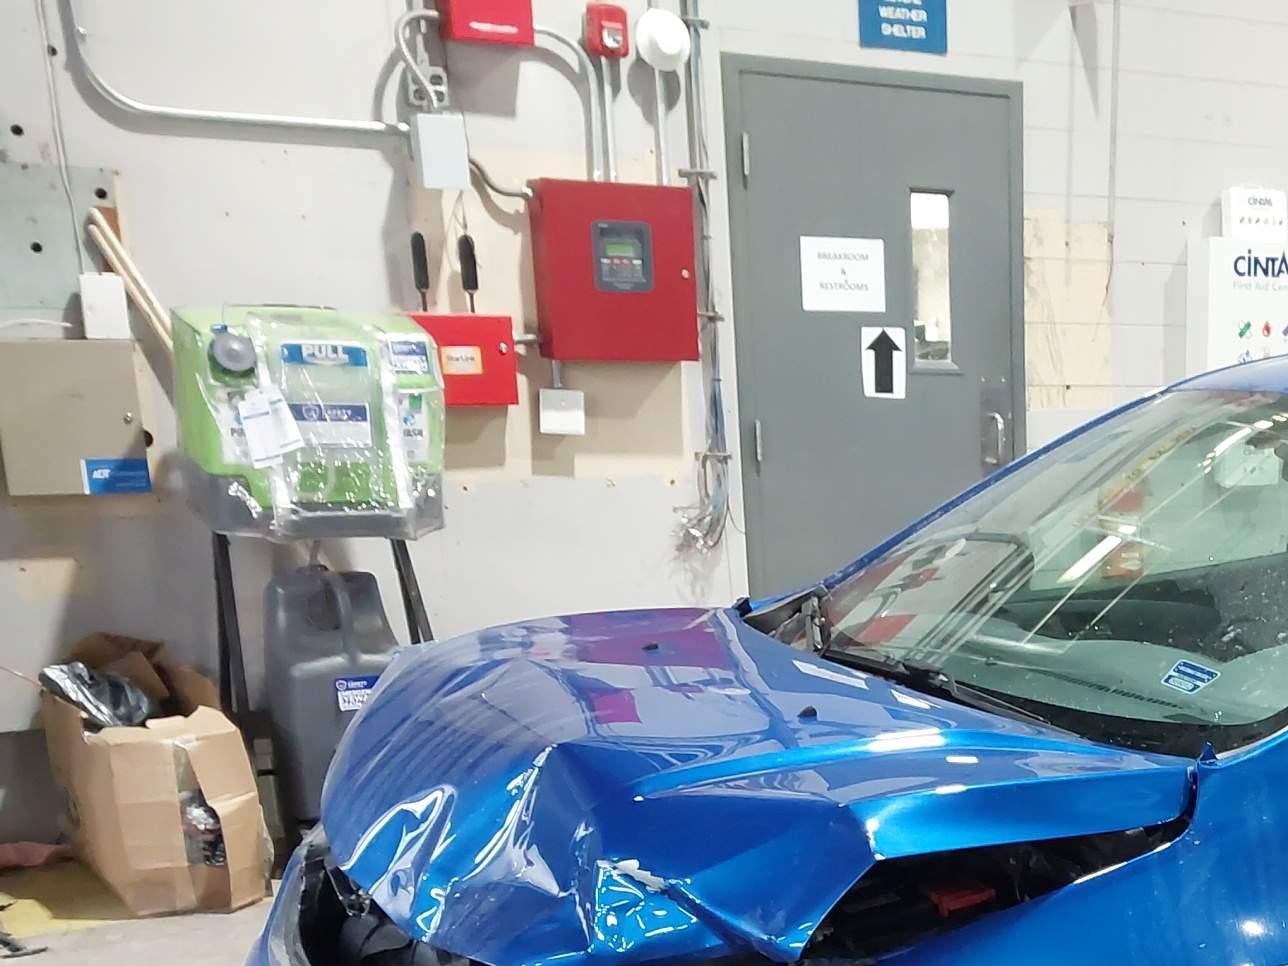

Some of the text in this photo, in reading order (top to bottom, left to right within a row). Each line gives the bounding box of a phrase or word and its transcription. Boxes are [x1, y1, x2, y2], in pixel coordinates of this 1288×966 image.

[879, 6, 928, 22] WEATHER
[881, 22, 927, 39] SHELTER
[817, 251, 869, 261] BREAKROOM
[819, 281, 869, 291] RESTROOMS
[302, 343, 349, 361] PULL
